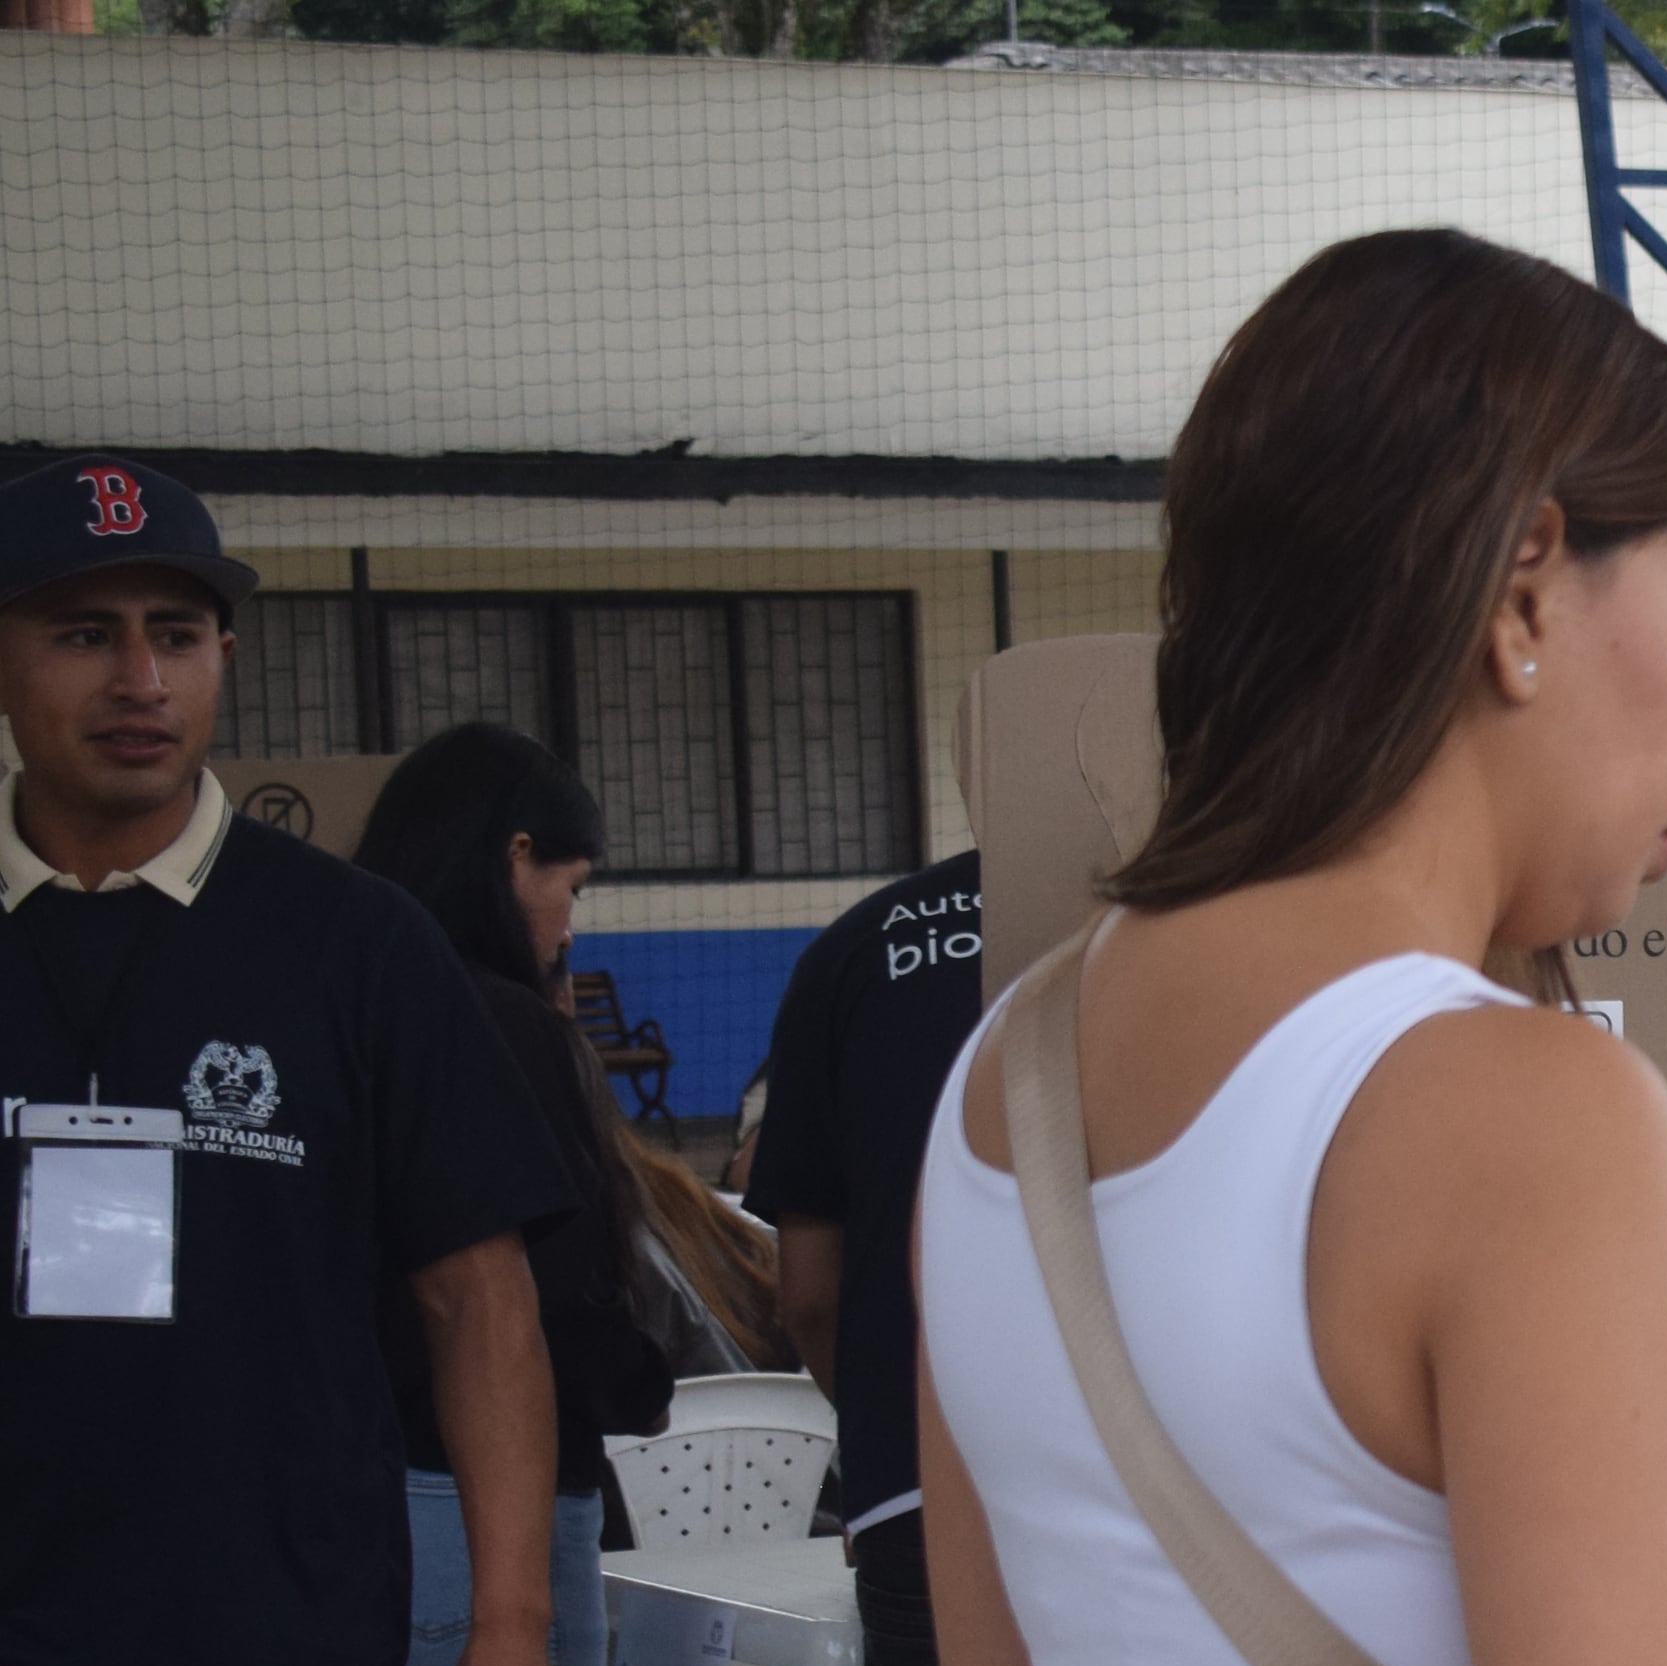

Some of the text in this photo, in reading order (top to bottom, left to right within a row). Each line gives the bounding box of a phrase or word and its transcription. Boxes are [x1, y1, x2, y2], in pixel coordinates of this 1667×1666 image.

[76, 465, 148, 535] B
[183, 1125, 305, 1156] ISTRADURÍA
[204, 1142, 226, 1153] DEL
[230, 1146, 277, 1161] ESTADO
[279, 1153, 304, 1166] CIVIL
